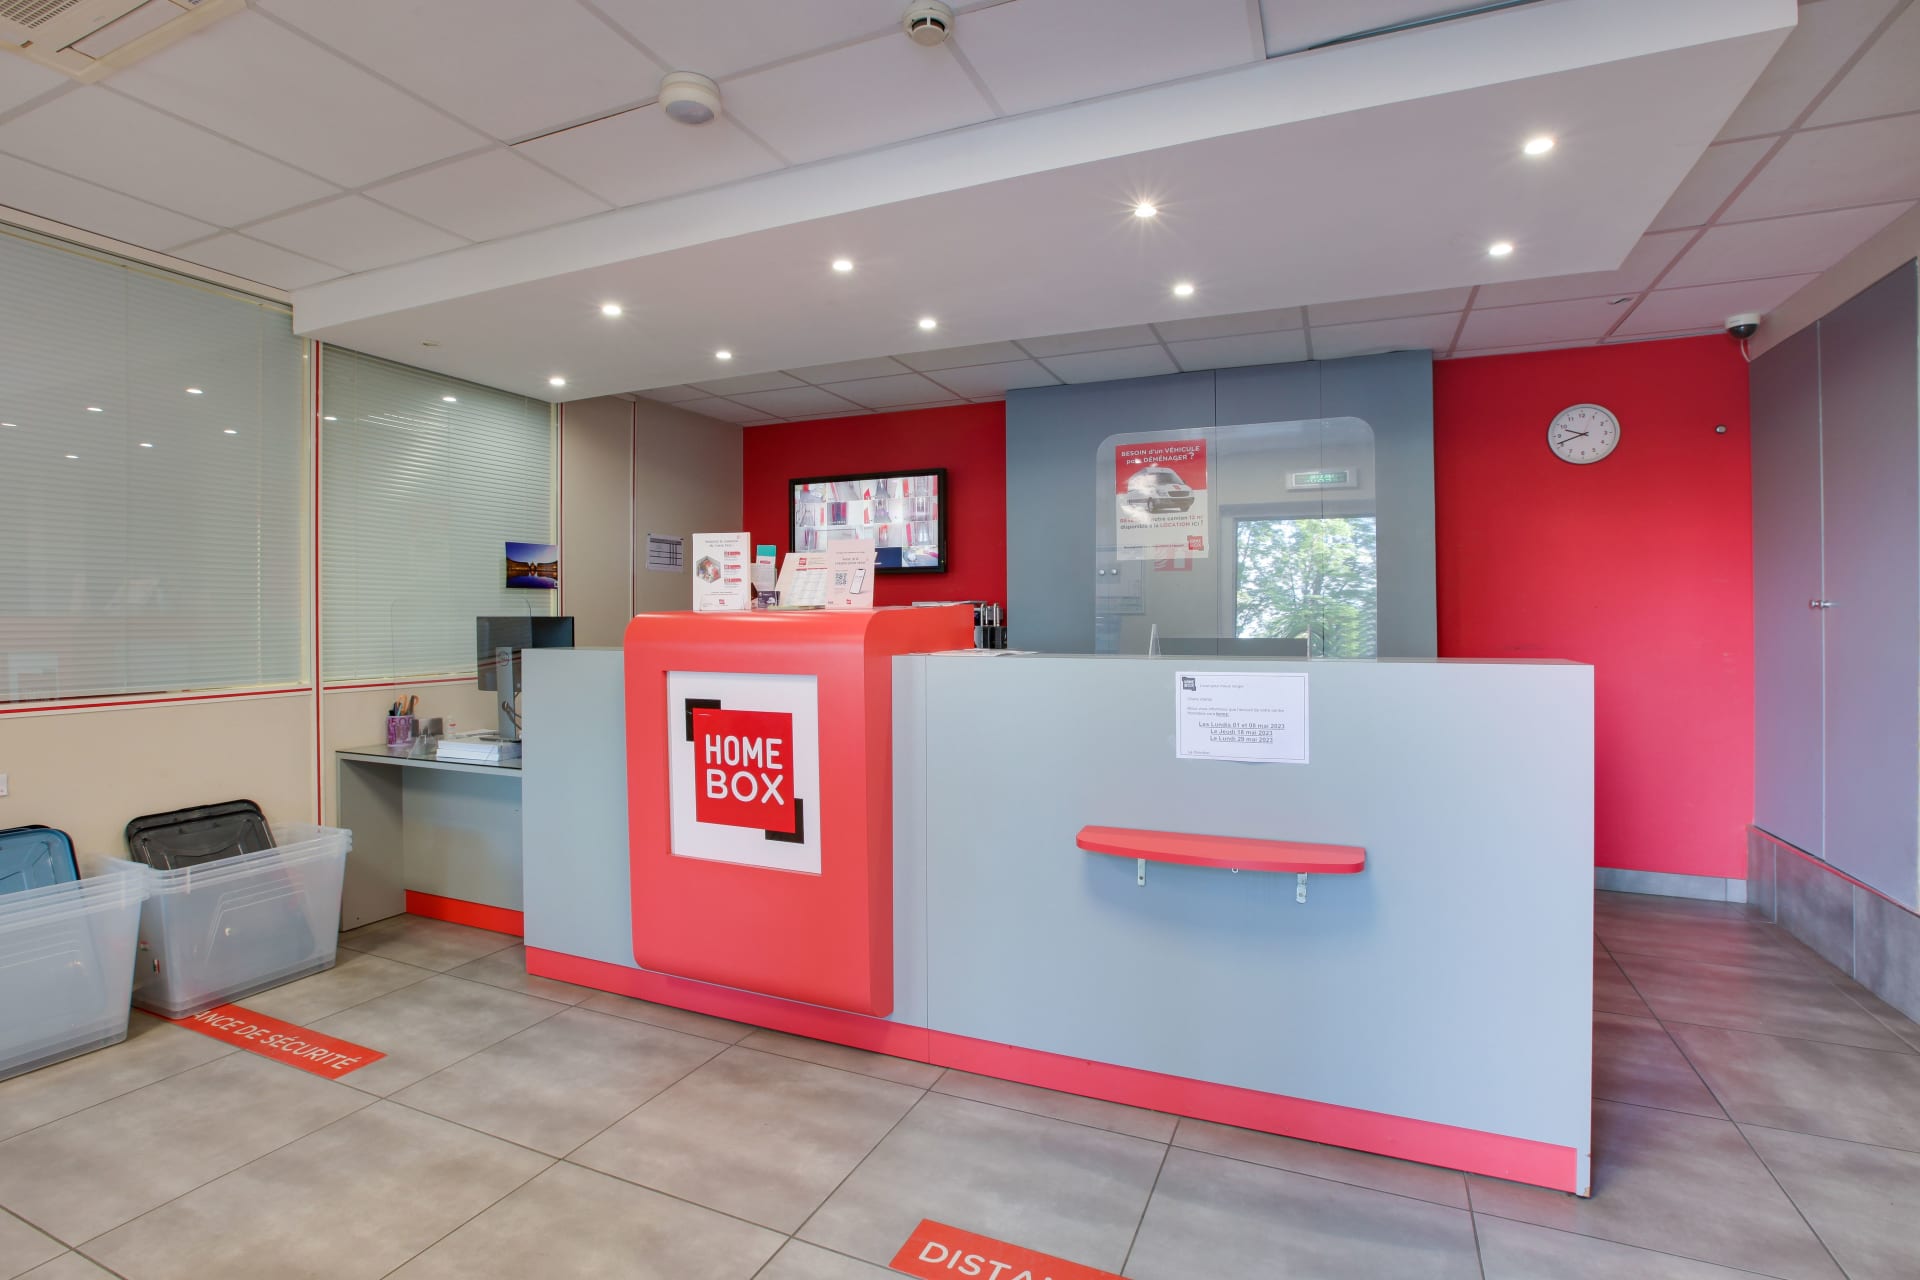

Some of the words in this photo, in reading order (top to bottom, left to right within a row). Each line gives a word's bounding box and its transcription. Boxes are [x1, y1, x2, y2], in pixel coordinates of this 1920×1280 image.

[705, 733, 783, 770] HOME
[706, 768, 785, 806] BOX
[233, 1025, 269, 1039] DE
[260, 1035, 362, 1069] SÉCURITÉ
[918, 1241, 1053, 1280] DIST
